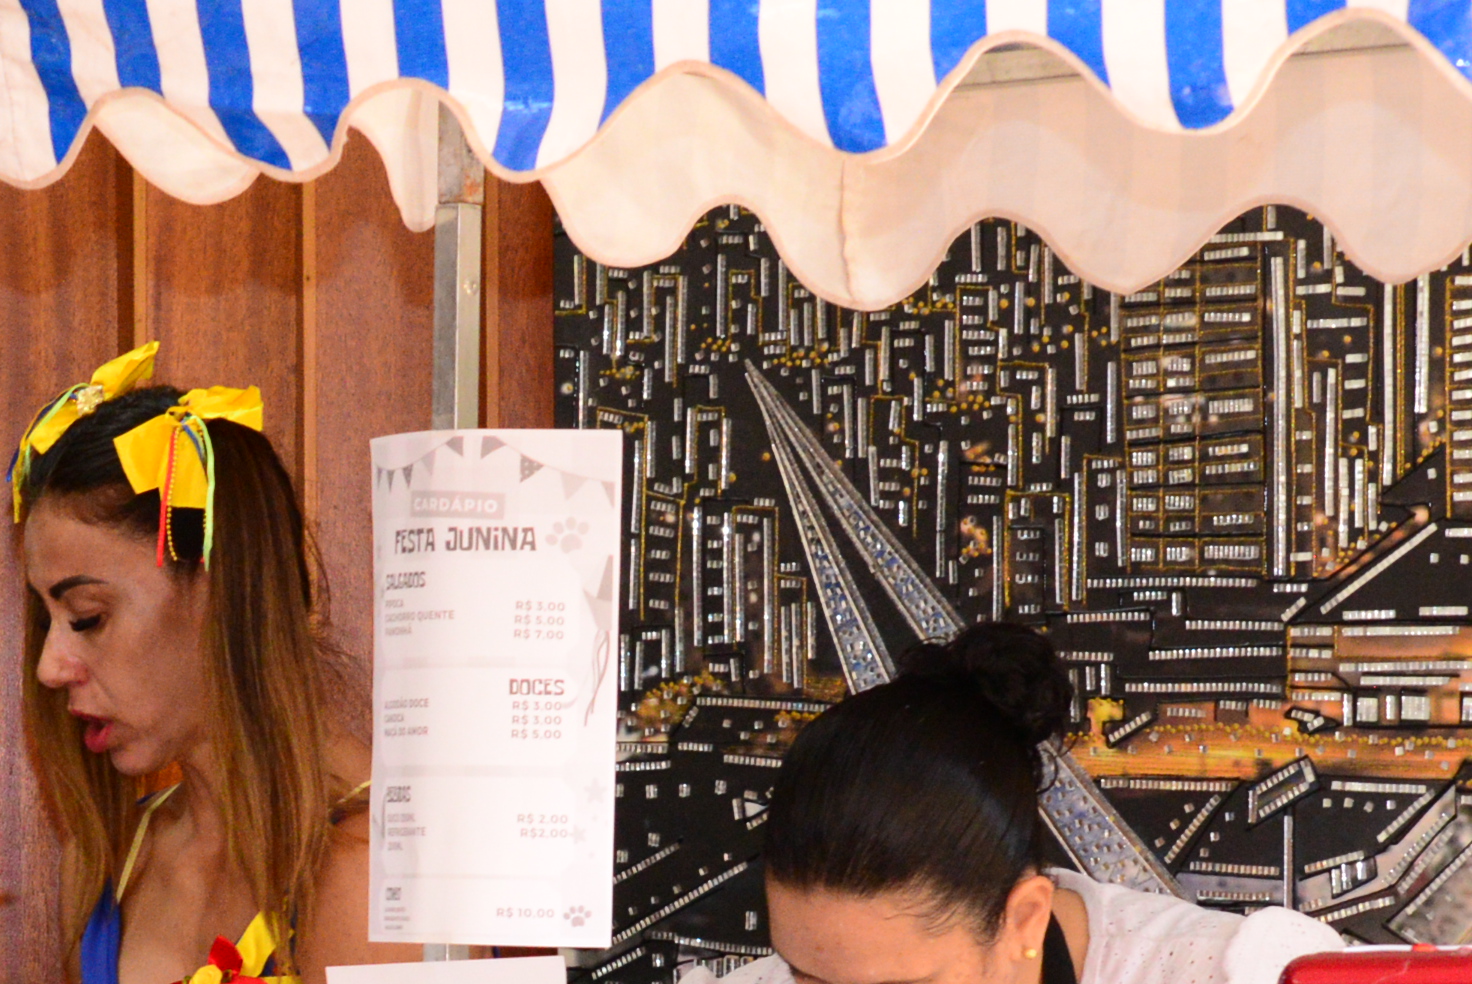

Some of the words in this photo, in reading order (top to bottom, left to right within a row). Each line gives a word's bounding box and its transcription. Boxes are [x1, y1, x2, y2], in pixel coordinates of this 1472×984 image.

[413, 494, 498, 513] CARDÁPIO
[394, 527, 436, 554] FESTA
[515, 599, 532, 612] R$
[417, 610, 455, 623] QUENTE
[514, 613, 531, 626] R$
[513, 628, 530, 640] R$
[509, 678, 565, 696] DOCES
[512, 700, 529, 711] R$
[511, 714, 529, 726] R$
[510, 728, 528, 740] R$
[516, 812, 534, 824] R$
[496, 907, 513, 918] R$
